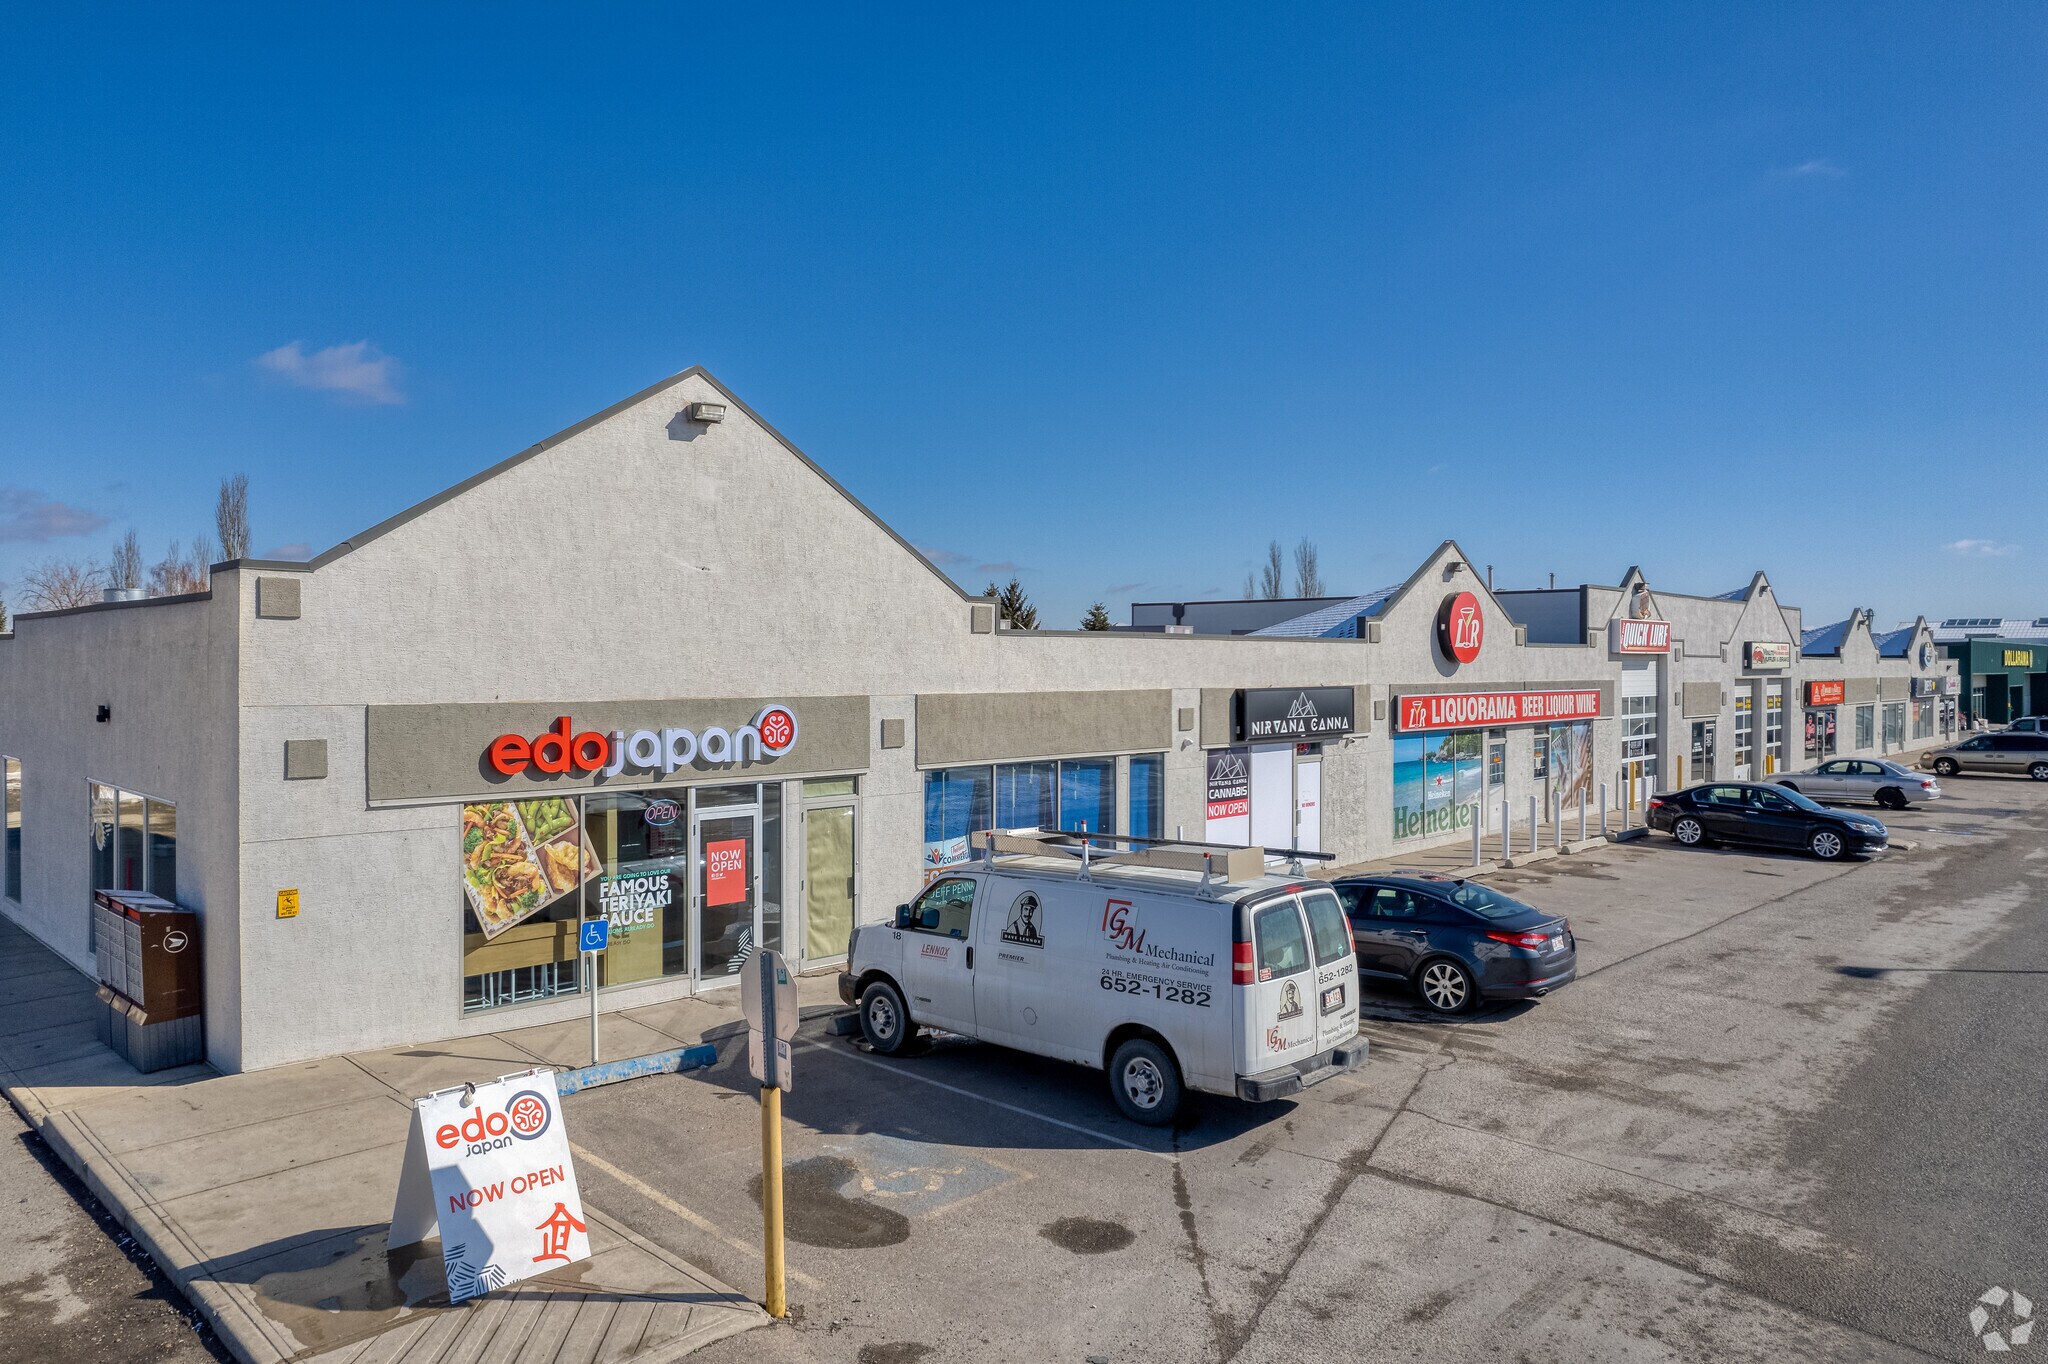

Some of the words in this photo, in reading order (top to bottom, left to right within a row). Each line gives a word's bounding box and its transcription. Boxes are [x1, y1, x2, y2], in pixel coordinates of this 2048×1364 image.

[1623, 623, 1649, 649] QUICK
[1650, 624, 1668, 647] LUBE
[2004, 650, 2029, 666] DOLLARAMA
[1431, 696, 1516, 724] LIQUORAMA
[1522, 695, 1544, 717] BEER
[1546, 694, 1575, 717] LIQUOR
[1575, 693, 1596, 714] WINE
[1251, 719, 1306, 735] NIRVANA
[1310, 716, 1349, 731] CANNA
[1208, 785, 1248, 799] CANNABIS
[647, 805, 678, 820] OPEN
[1208, 803, 1228, 817] NOW
[1228, 801, 1248, 814] OPEN
[711, 849, 741, 862] NOW
[711, 859, 742, 872] OPEN
[600, 875, 669, 898] FAMOUS
[931, 886, 951, 899] JEFF
[600, 889, 672, 913] TERIYAKI
[624, 924, 646, 932] ALREADY
[893, 931, 902, 940] 18
[1004, 933, 1018, 941] DAVE
[1020, 936, 1041, 944] LENNOX
[921, 943, 950, 957] LENNOX
[998, 952, 1025, 962] PREMIER
[1145, 943, 1215, 967] Mechanical
[1105, 952, 1131, 965] Plumbing
[1138, 957, 1160, 969] Heating
[1171, 963, 1210, 977] Conditioning
[1101, 968, 1110, 976] 24
[1112, 969, 1125, 978] HR.
[1126, 972, 1175, 986] EMERGENCY
[1176, 980, 1212, 993] SERVICE
[1318, 963, 1353, 984] 652-1282
[1100, 975, 1211, 1008] 652-1282
[1287, 1034, 1314, 1049] Mechanical
[436, 1106, 509, 1149] edo
[466, 1135, 513, 1157] japan
[449, 1181, 505, 1214] NOW
[511, 1165, 565, 1195] OPEN
